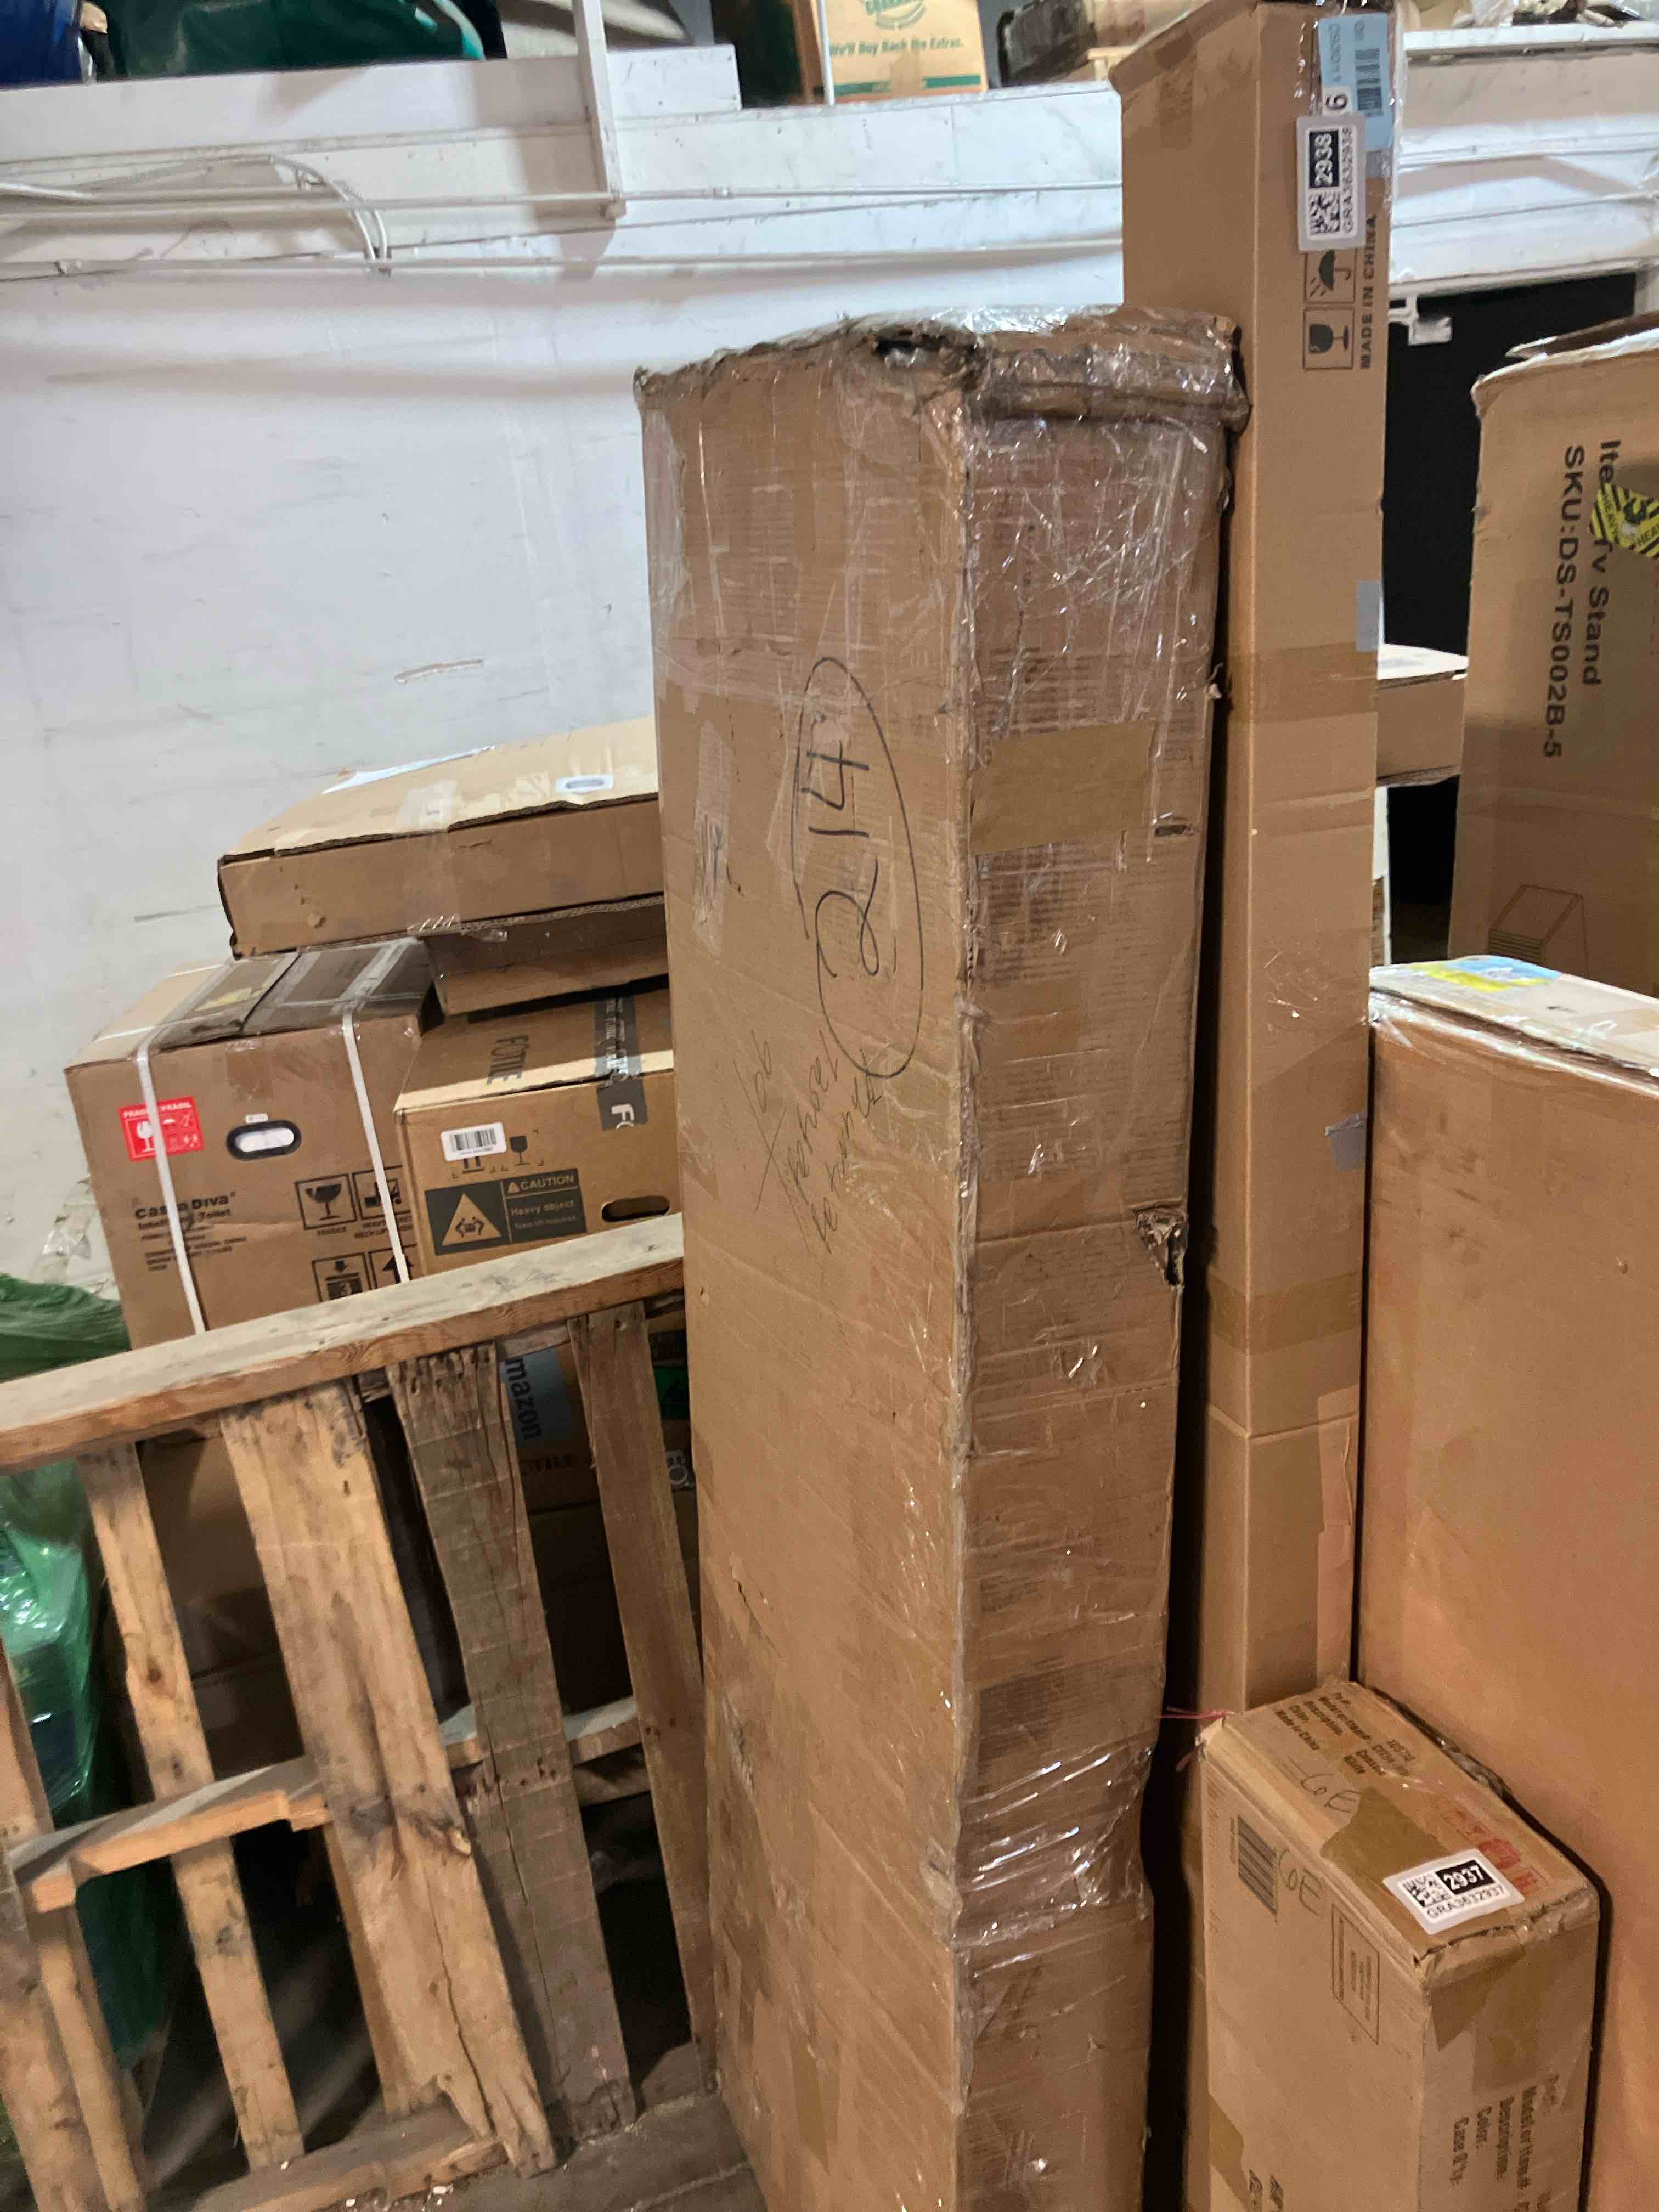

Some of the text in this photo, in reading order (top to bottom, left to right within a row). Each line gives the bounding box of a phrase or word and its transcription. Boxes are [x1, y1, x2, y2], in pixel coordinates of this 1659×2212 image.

[1314, 134, 1333, 186] 2938
[1360, 215, 1376, 369] MADE IN CHINA
[1599, 439, 1621, 484] Ite
[1544, 445, 1585, 757] SKU:DS-TS002B-5
[1583, 586, 1610, 685] Stand
[800, 740, 878, 977] 214
[510, 1206, 541, 1216] Heavy
[521, 1175, 574, 1190] CAUTION
[504, 1358, 542, 1440] mazon
[1443, 1865, 1485, 1891] 2937
